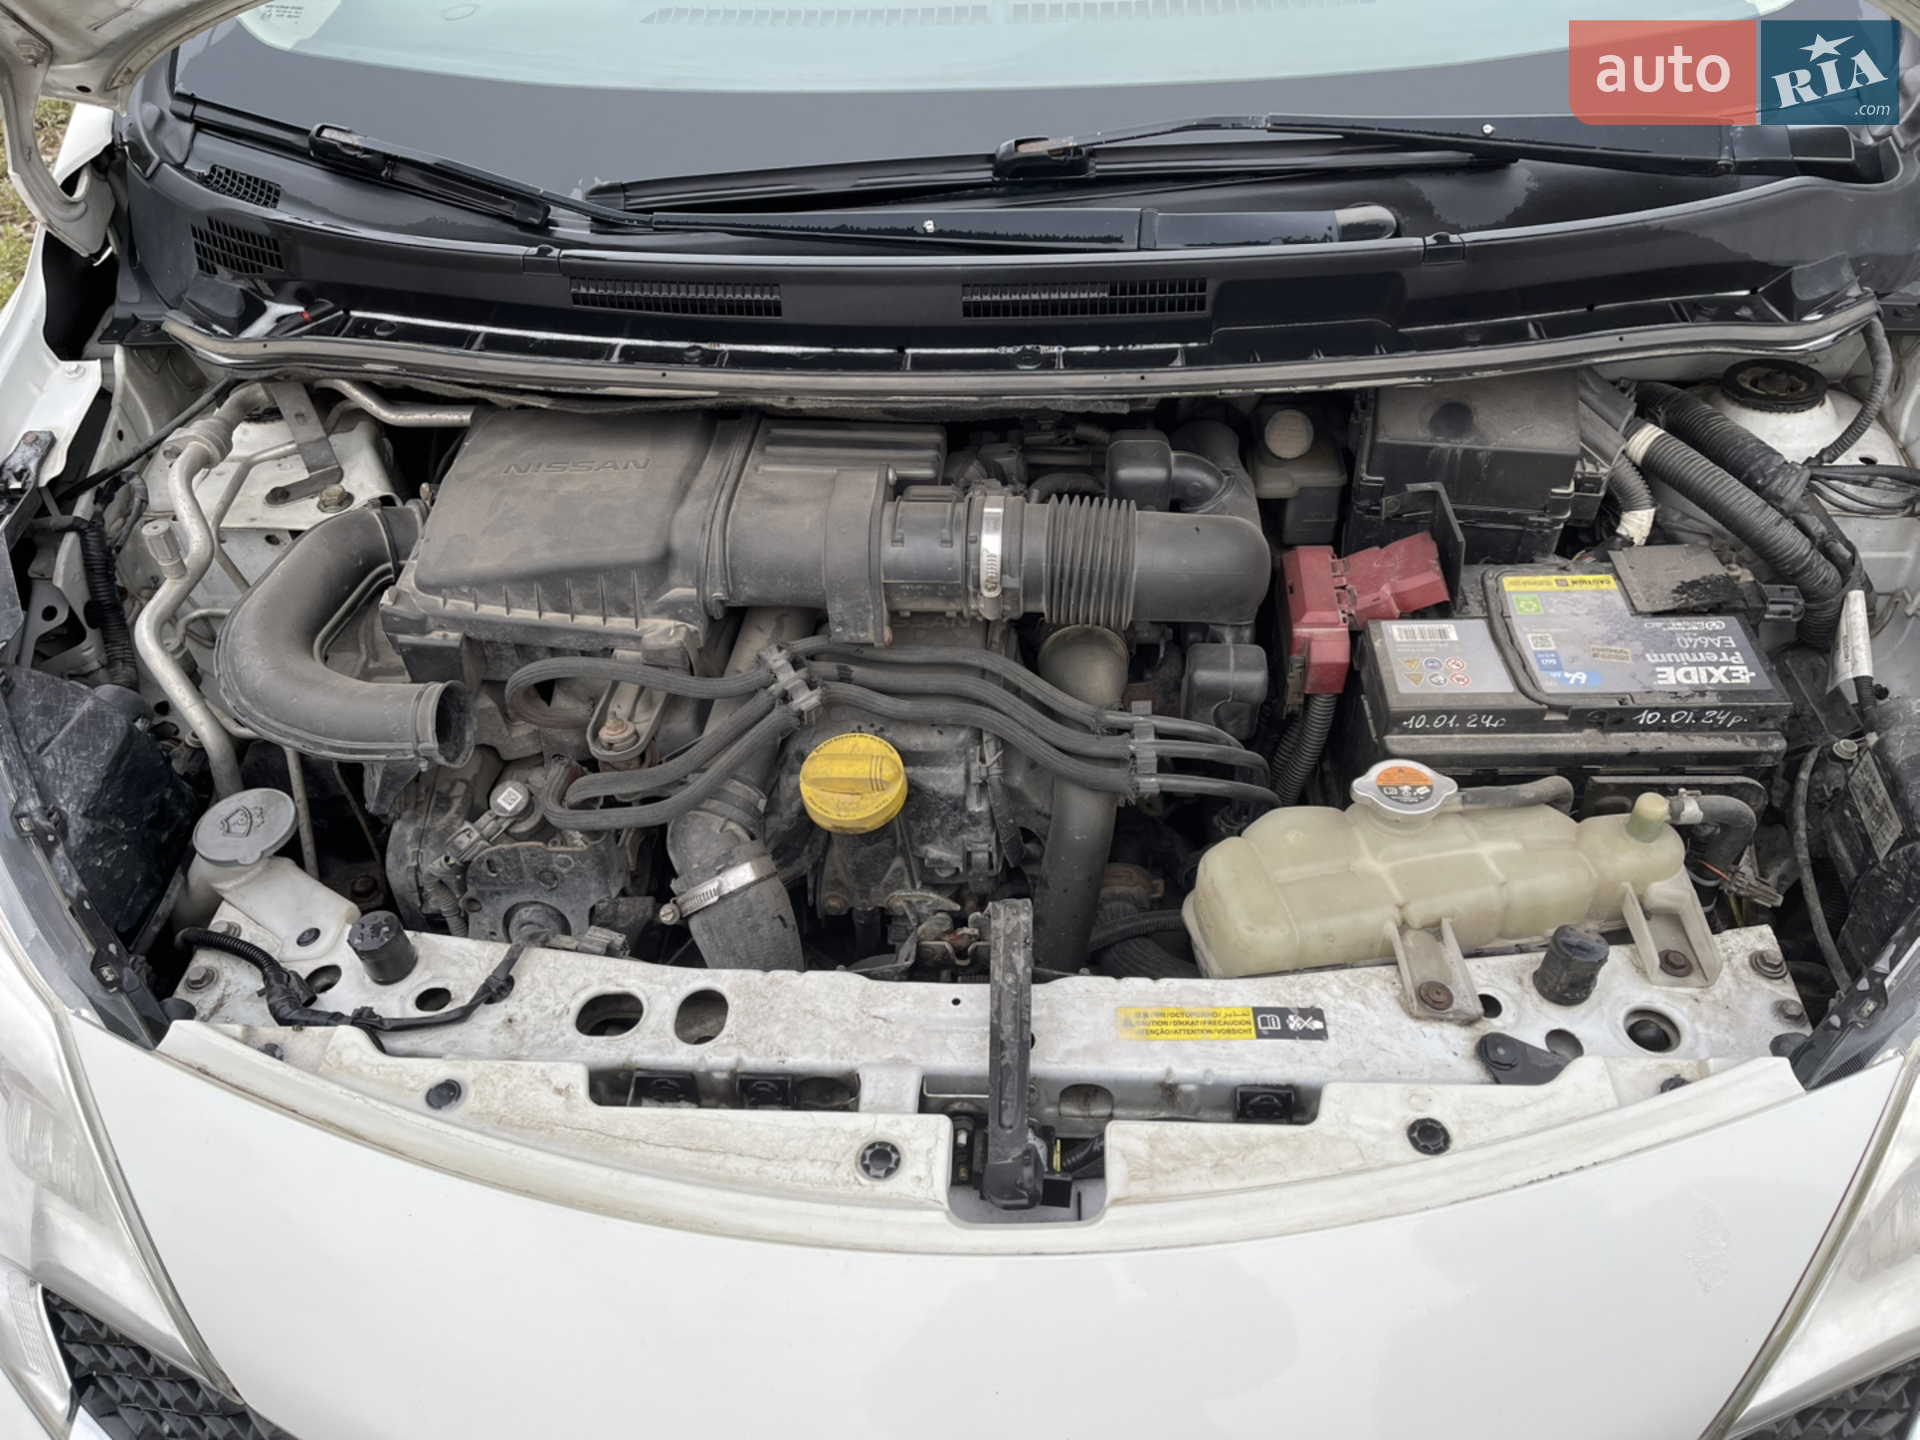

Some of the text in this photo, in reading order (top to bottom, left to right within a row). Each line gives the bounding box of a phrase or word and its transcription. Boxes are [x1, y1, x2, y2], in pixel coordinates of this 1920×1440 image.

[502, 458, 651, 475] NISSAN
[1676, 635, 1737, 648] EA640
[1644, 651, 1746, 665] Premium
[1654, 665, 1756, 685] EXIDE
